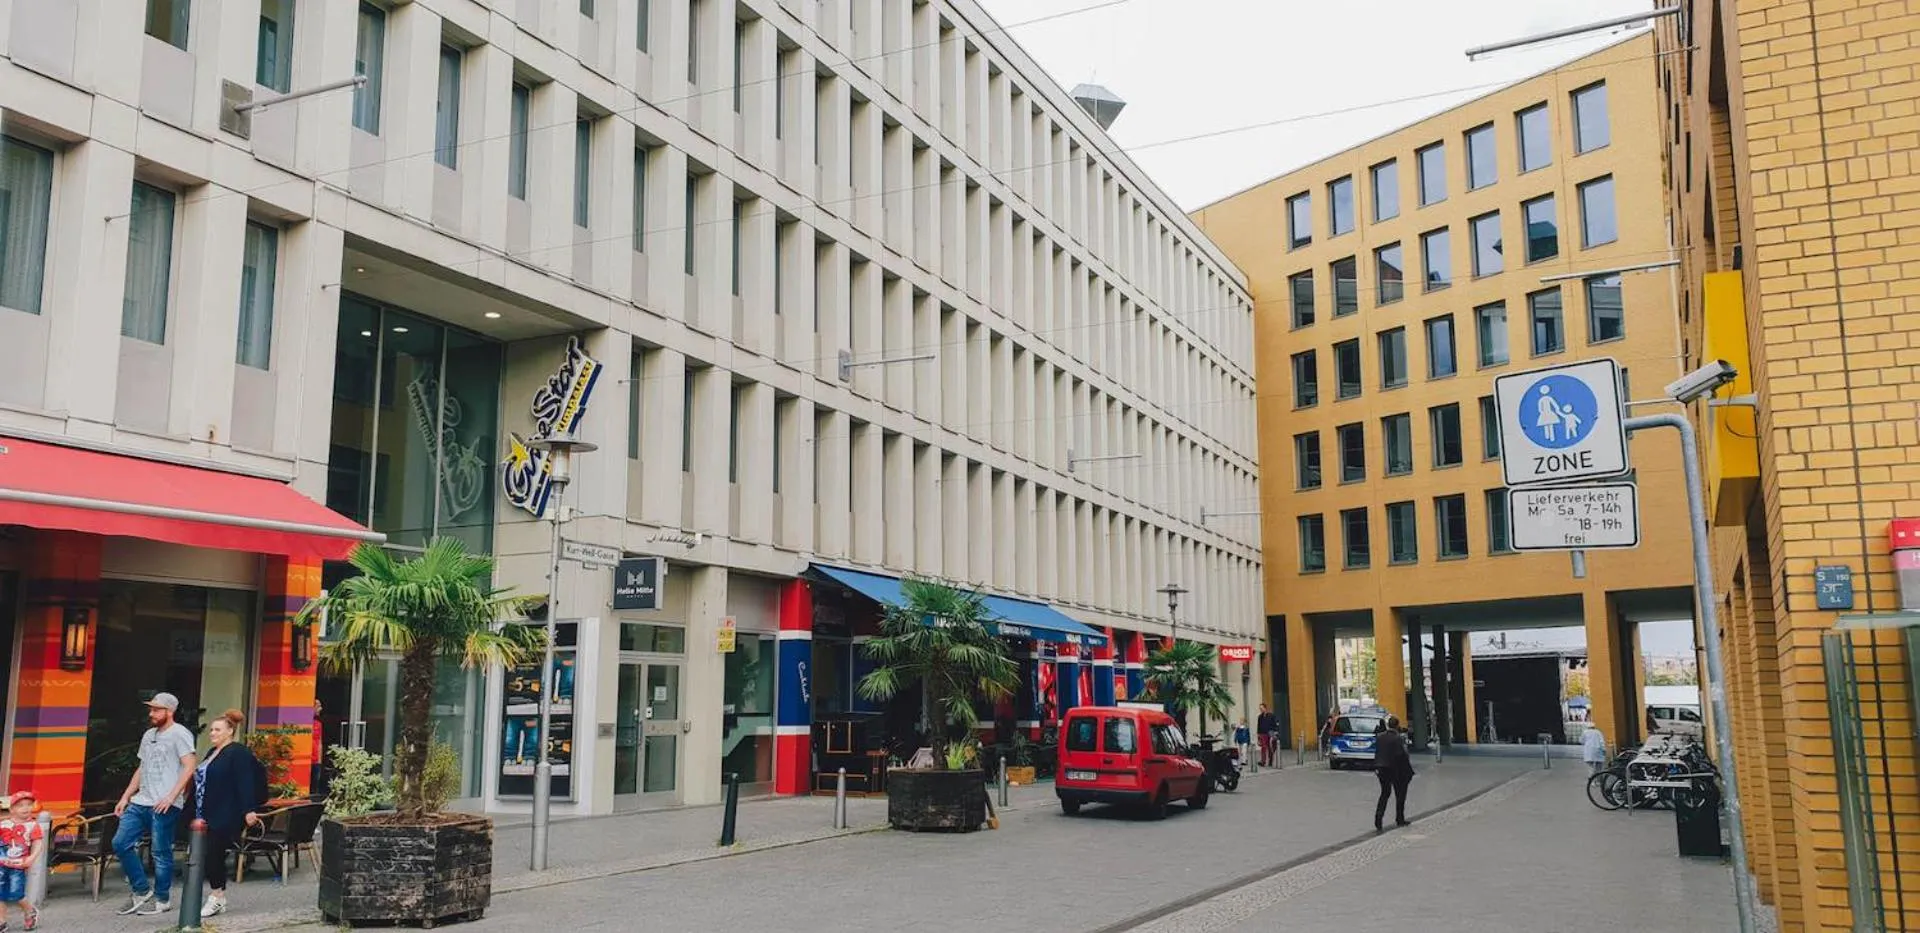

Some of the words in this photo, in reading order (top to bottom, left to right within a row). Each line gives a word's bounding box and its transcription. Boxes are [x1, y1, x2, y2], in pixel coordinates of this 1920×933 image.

[1533, 450, 1593, 475] ZONE
[1527, 491, 1620, 505] Lieferverkehr
[1558, 505, 1574, 516] Sa
[1584, 502, 1621, 515] 7-14h
[1579, 518, 1622, 531] 18-19h
[1564, 533, 1586, 545] frei
[1816, 571, 1826, 581] S
[1222, 648, 1249, 656] ORION
